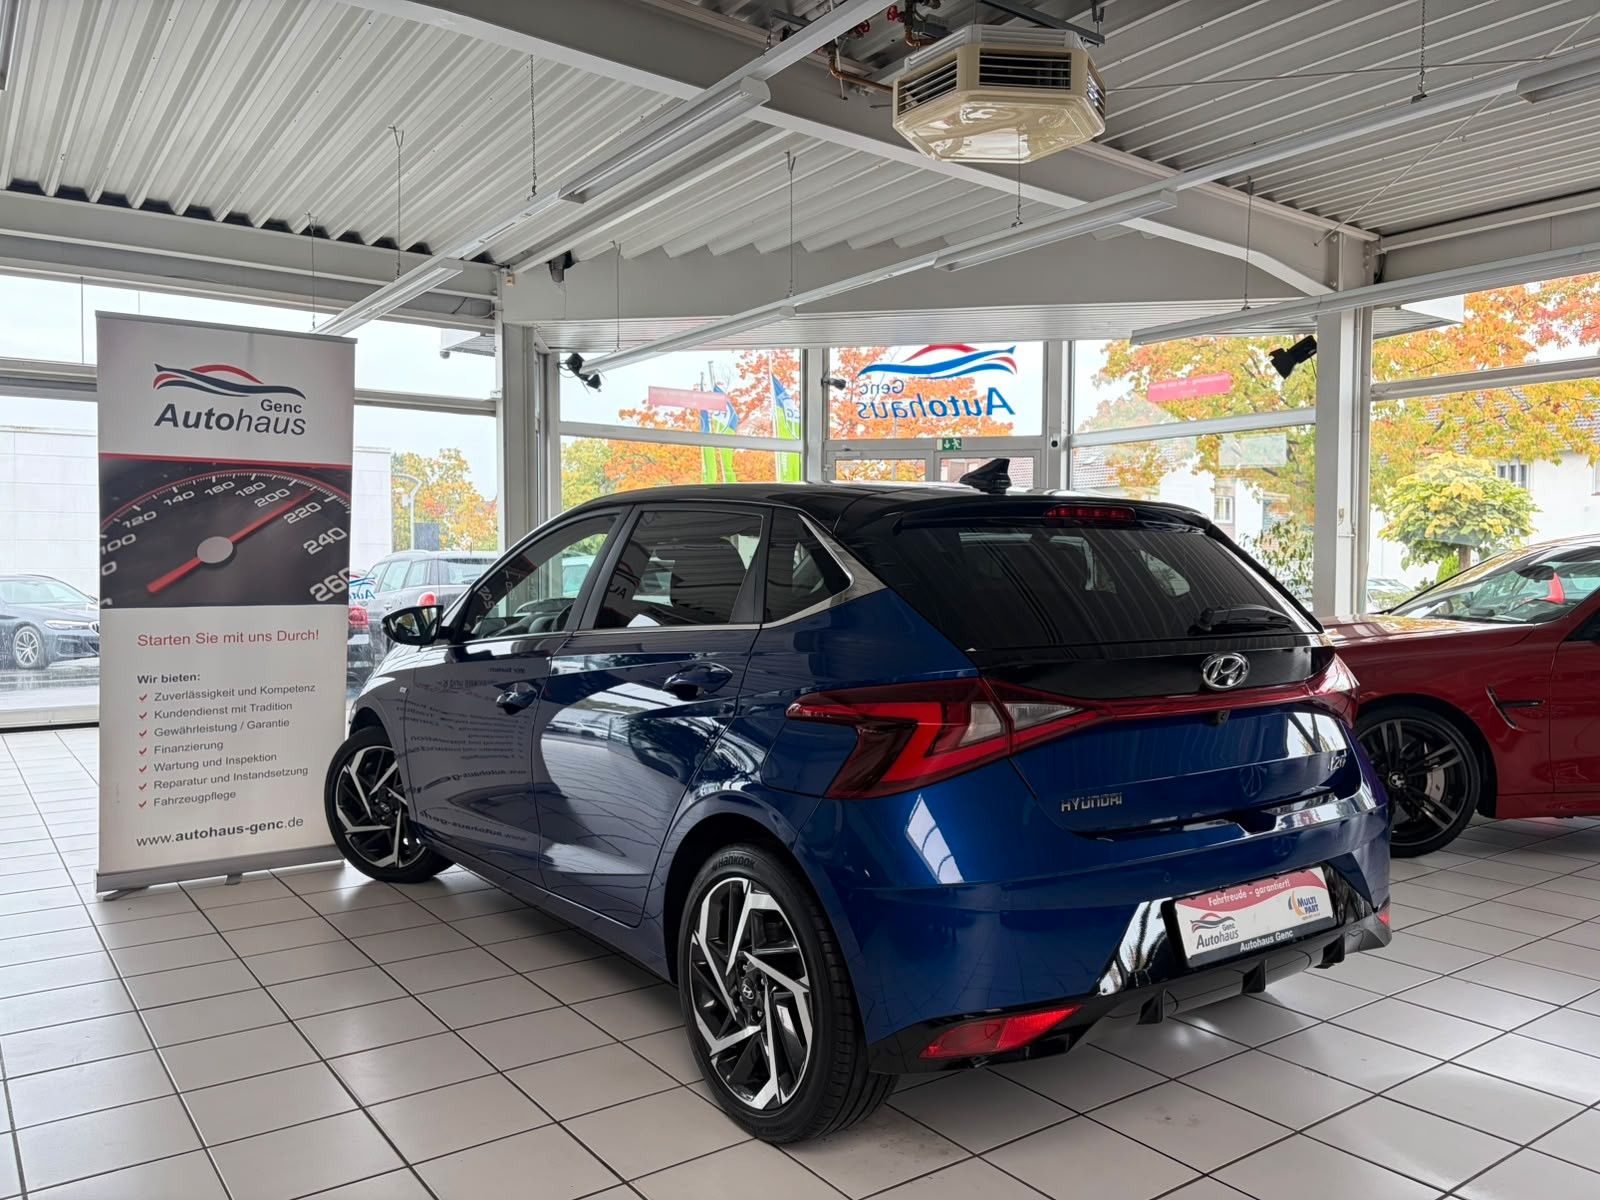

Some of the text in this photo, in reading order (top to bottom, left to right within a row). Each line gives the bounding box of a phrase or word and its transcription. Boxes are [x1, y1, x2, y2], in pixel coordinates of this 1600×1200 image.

[260, 399, 302, 414] Genc
[154, 403, 306, 435] Autohaus
[204, 481, 235, 496] 160
[235, 481, 266, 497] 180
[164, 491, 195, 505] 140
[254, 488, 291, 508] 200
[122, 511, 156, 528] 120
[283, 501, 322, 524] 220
[303, 527, 347, 555] 240
[137, 629, 319, 647] Starten Sie mit uns Durch!
[137, 673, 201, 684] Wir bieten:
[154, 684, 316, 702] Zuverlässigkeit und Kompetenz
[154, 702, 293, 720] Kundendienst mit Tradition
[154, 718, 290, 737] Gewährleistung / Garantie
[154, 741, 224, 755] Finanzierung
[154, 753, 277, 772] Wartung und Inspektion
[154, 766, 309, 790] Reparatur und Instandsetzung
[154, 791, 236, 806] Fahrzeugpflege
[1060, 791, 1122, 812] HYUNDAI
[136, 816, 304, 847] www.autohaus-genc.de
[1208, 890, 1247, 906] Fahrfreude
[1254, 879, 1291, 897] garantiert!
[1297, 895, 1317, 907] MULTI
[1304, 904, 1319, 914] PART
[1222, 923, 1236, 931] Genc
[1196, 929, 1239, 949] Autohaus
[1239, 930, 1294, 953] Autohaus Genc
